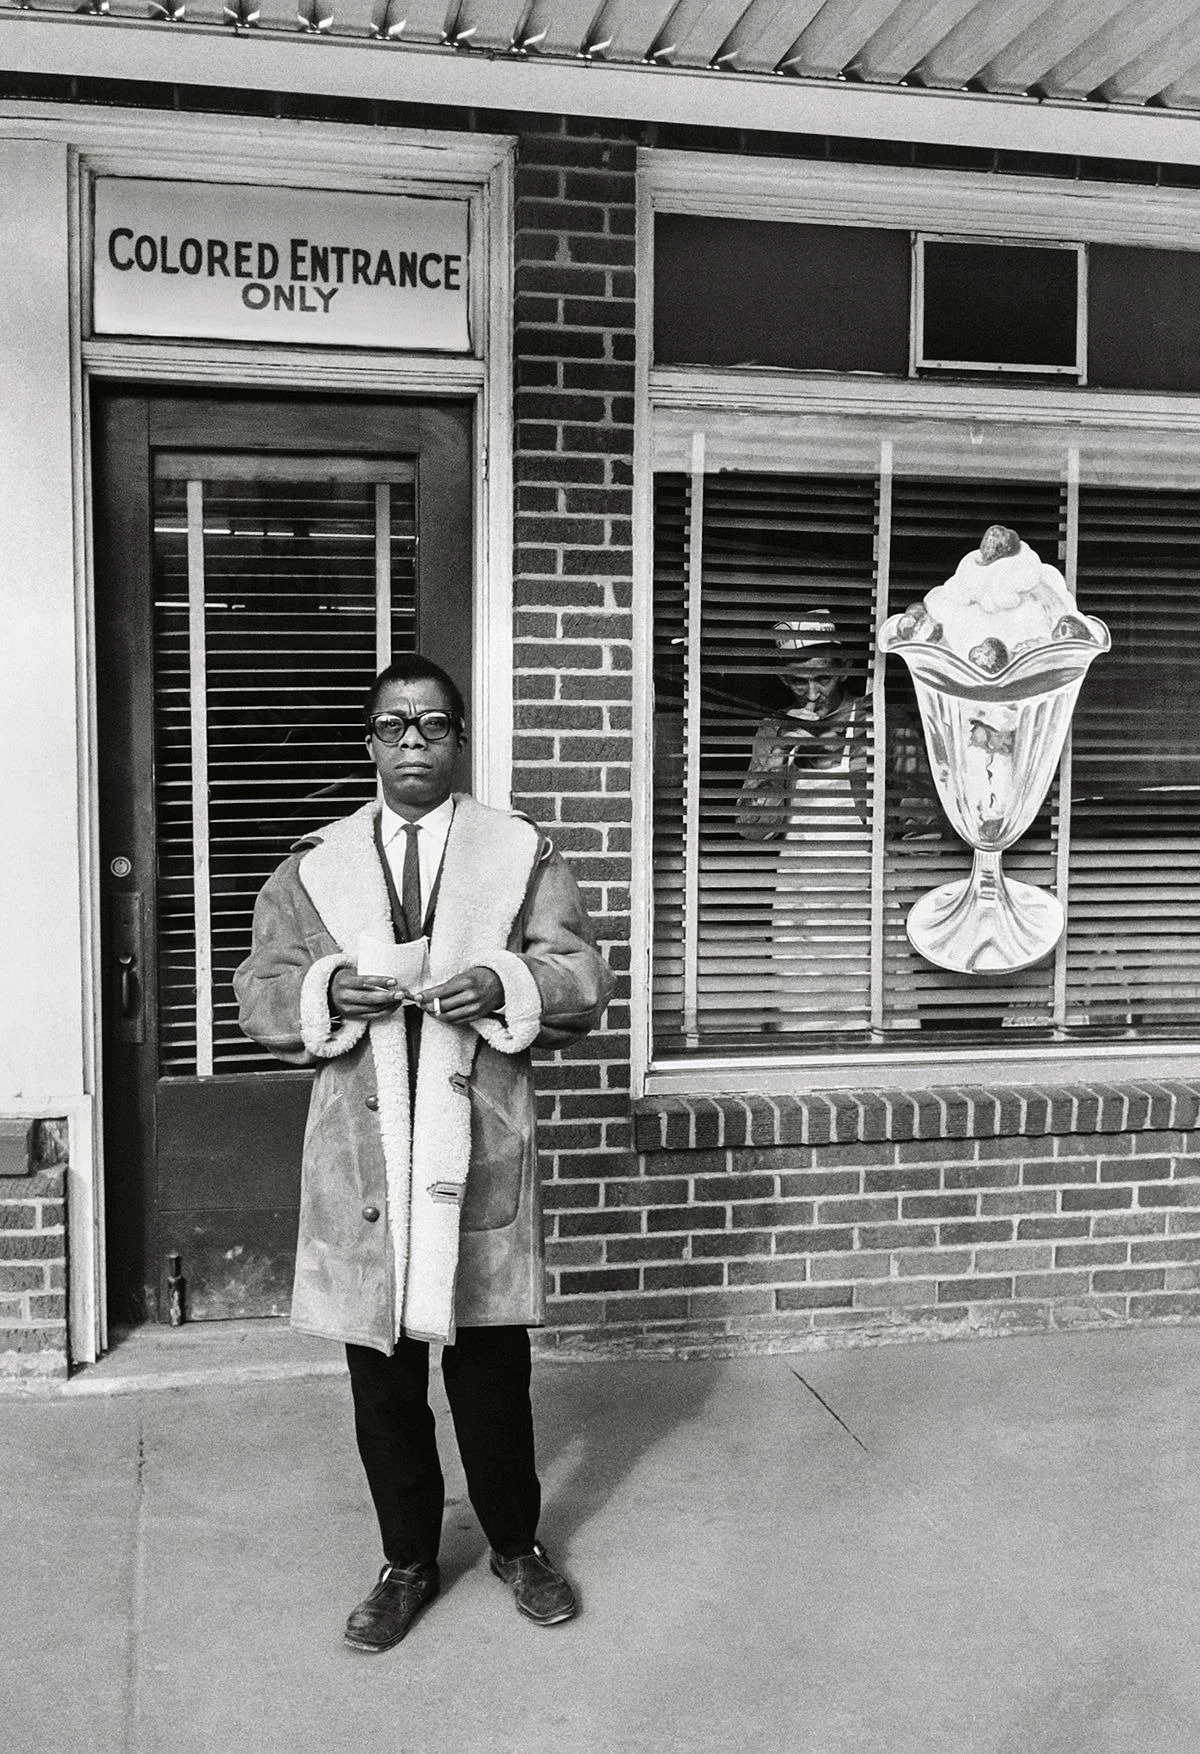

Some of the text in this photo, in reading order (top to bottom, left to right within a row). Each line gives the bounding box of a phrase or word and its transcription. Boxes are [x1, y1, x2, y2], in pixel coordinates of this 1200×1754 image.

[108, 228, 461, 290] COLORED ENTRANCE
[242, 282, 339, 313] ONLY
